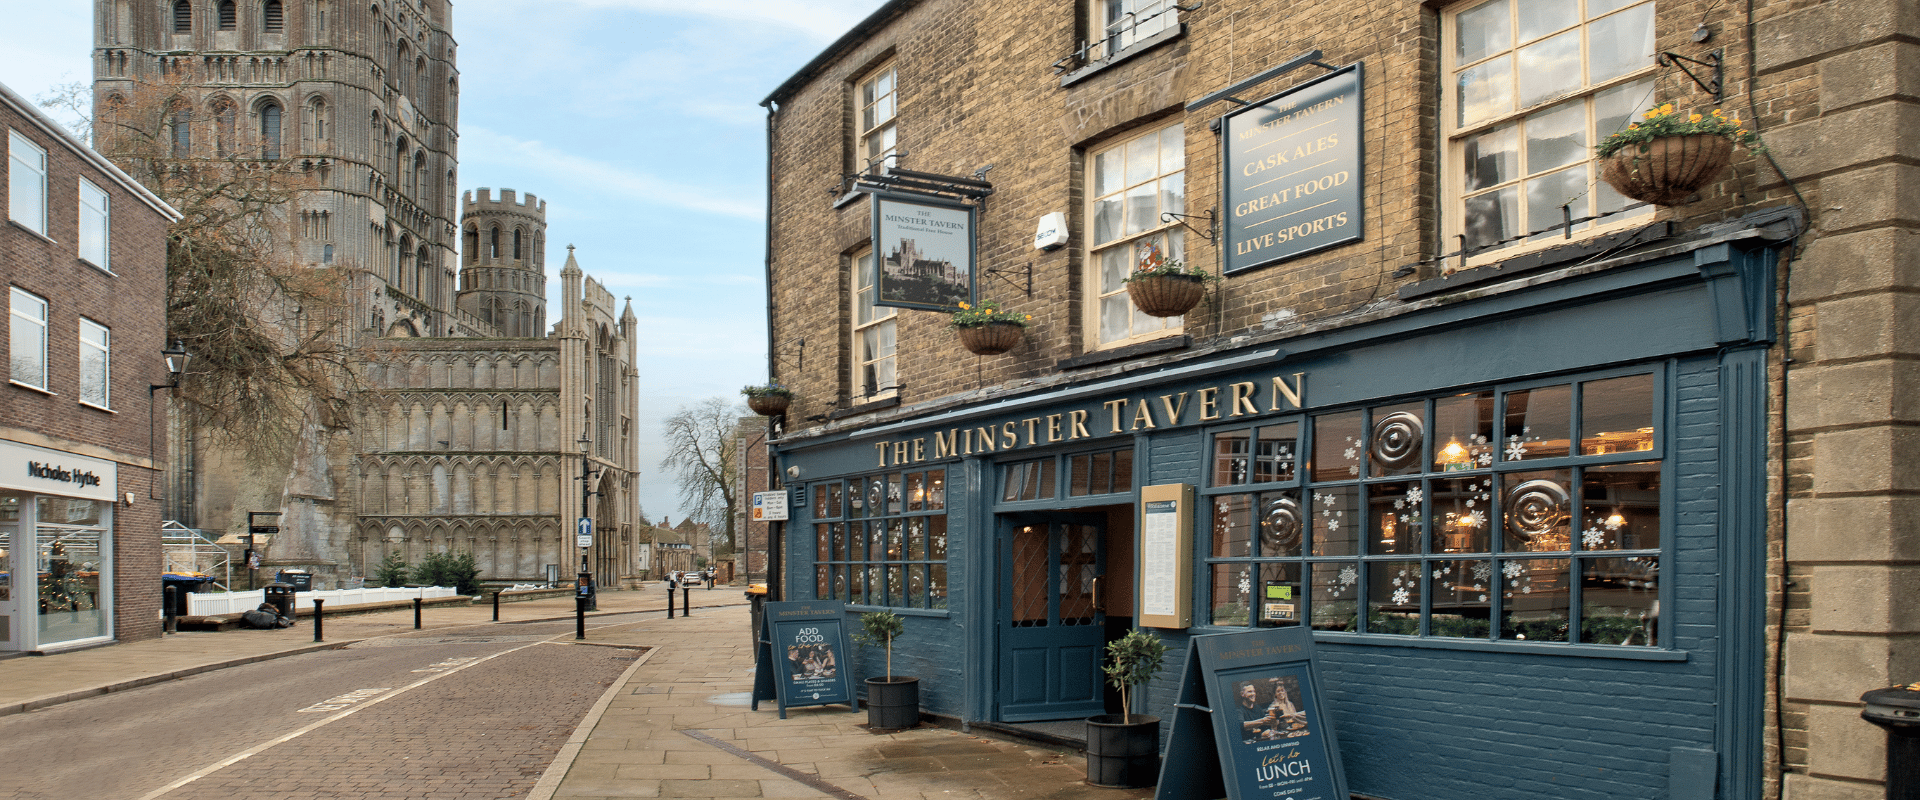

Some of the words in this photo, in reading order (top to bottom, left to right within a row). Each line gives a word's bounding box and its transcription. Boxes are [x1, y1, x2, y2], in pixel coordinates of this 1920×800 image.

[1238, 114, 1291, 142] MINSTER
[1293, 94, 1344, 120] TAVERN
[1277, 101, 1297, 113] THE
[1243, 150, 1289, 177] CASK
[1292, 133, 1338, 160] ALES
[1235, 188, 1291, 217] GREAT
[1294, 170, 1349, 199] FOOD
[885, 214, 927, 226] MINSTER
[929, 219, 964, 230] TAVERN
[1236, 232, 1274, 256] LIVE
[1277, 211, 1348, 244] SPORTS
[875, 438, 925, 468] THE
[933, 408, 1091, 460] MINSTER
[1103, 371, 1306, 435] TAVERN
[28, 460, 72, 483] Nicholas
[72, 468, 101, 489] Hythe
[795, 635, 824, 643] FOOD
[799, 627, 819, 636] ADD
[1219, 648, 1264, 660] MINSTER
[1266, 644, 1301, 655] TAVERN
[1262, 752, 1286, 767] Let's
[1287, 747, 1300, 759] do
[1256, 759, 1311, 782] LUNCH
